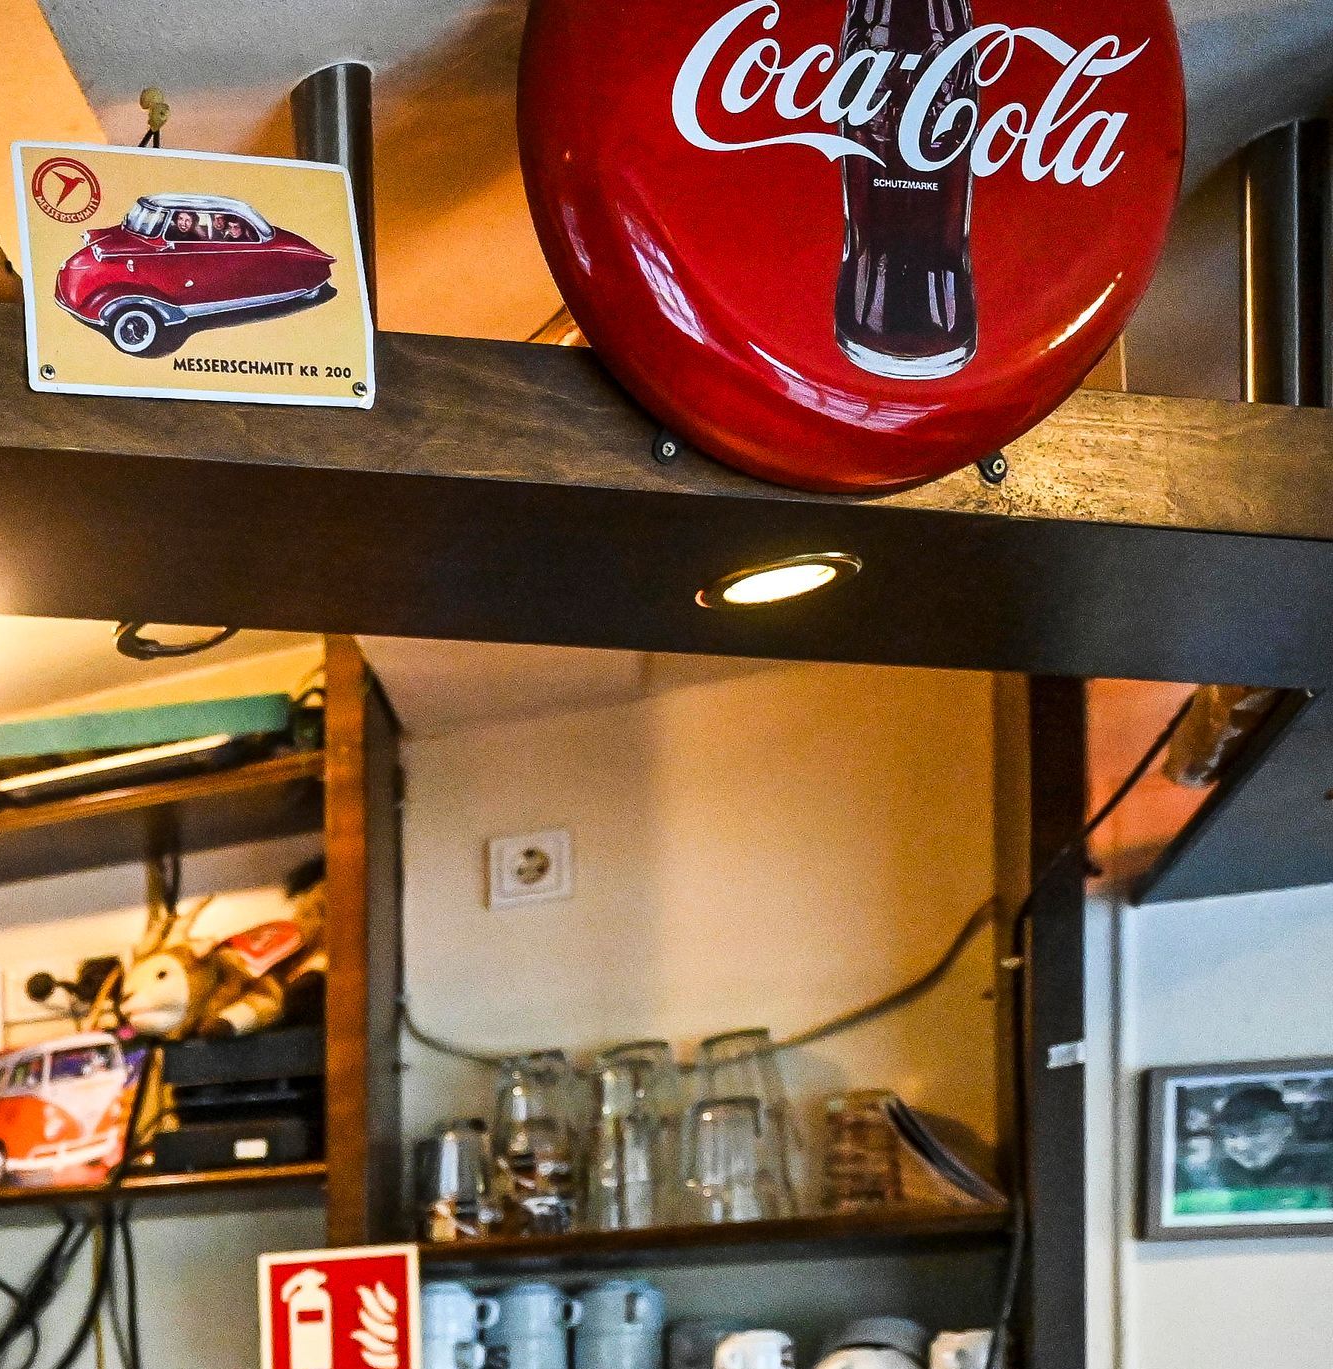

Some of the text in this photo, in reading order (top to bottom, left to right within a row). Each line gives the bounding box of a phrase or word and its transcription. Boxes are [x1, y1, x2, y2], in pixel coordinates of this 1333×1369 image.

[672, 0, 1150, 187] Coca-Cola
[873, 178, 939, 191] SCHUTZMARKE
[35, 195, 99, 222] MESSERSCHMITT
[173, 358, 352, 378] MESSERSCHMITT KR 200
